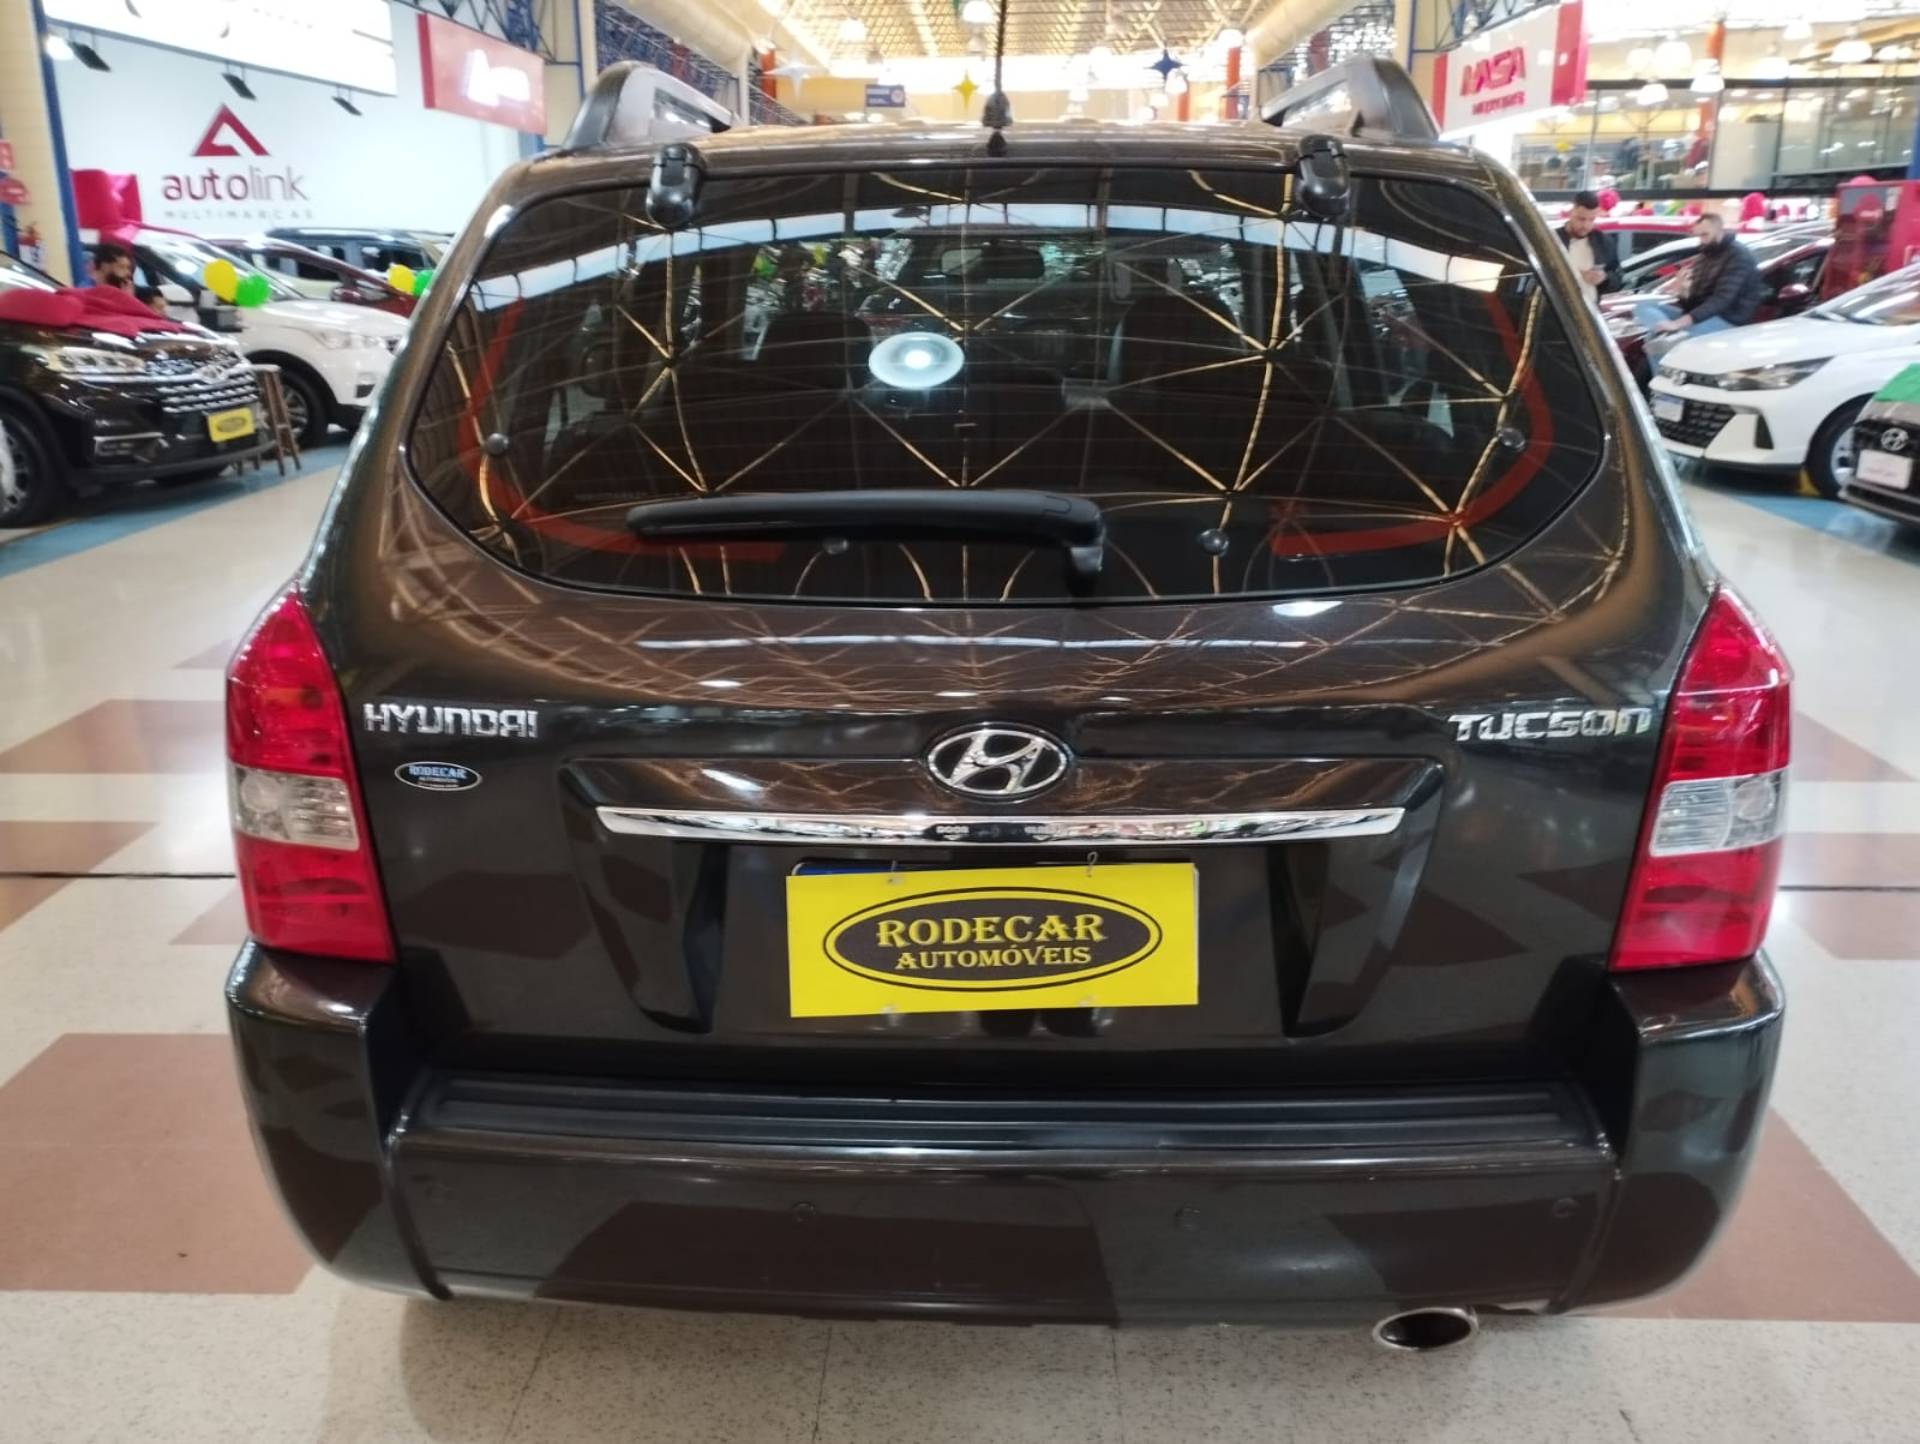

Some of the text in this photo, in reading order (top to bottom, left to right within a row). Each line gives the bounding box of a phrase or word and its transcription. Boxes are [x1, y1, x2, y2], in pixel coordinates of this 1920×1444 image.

[161, 164, 310, 201] autolink
[363, 703, 539, 738] HYUNDAI
[1448, 707, 1652, 741] TUCSON
[876, 913, 1107, 947] RODECAR
[894, 944, 1092, 970] AUTOMÓVEIS
